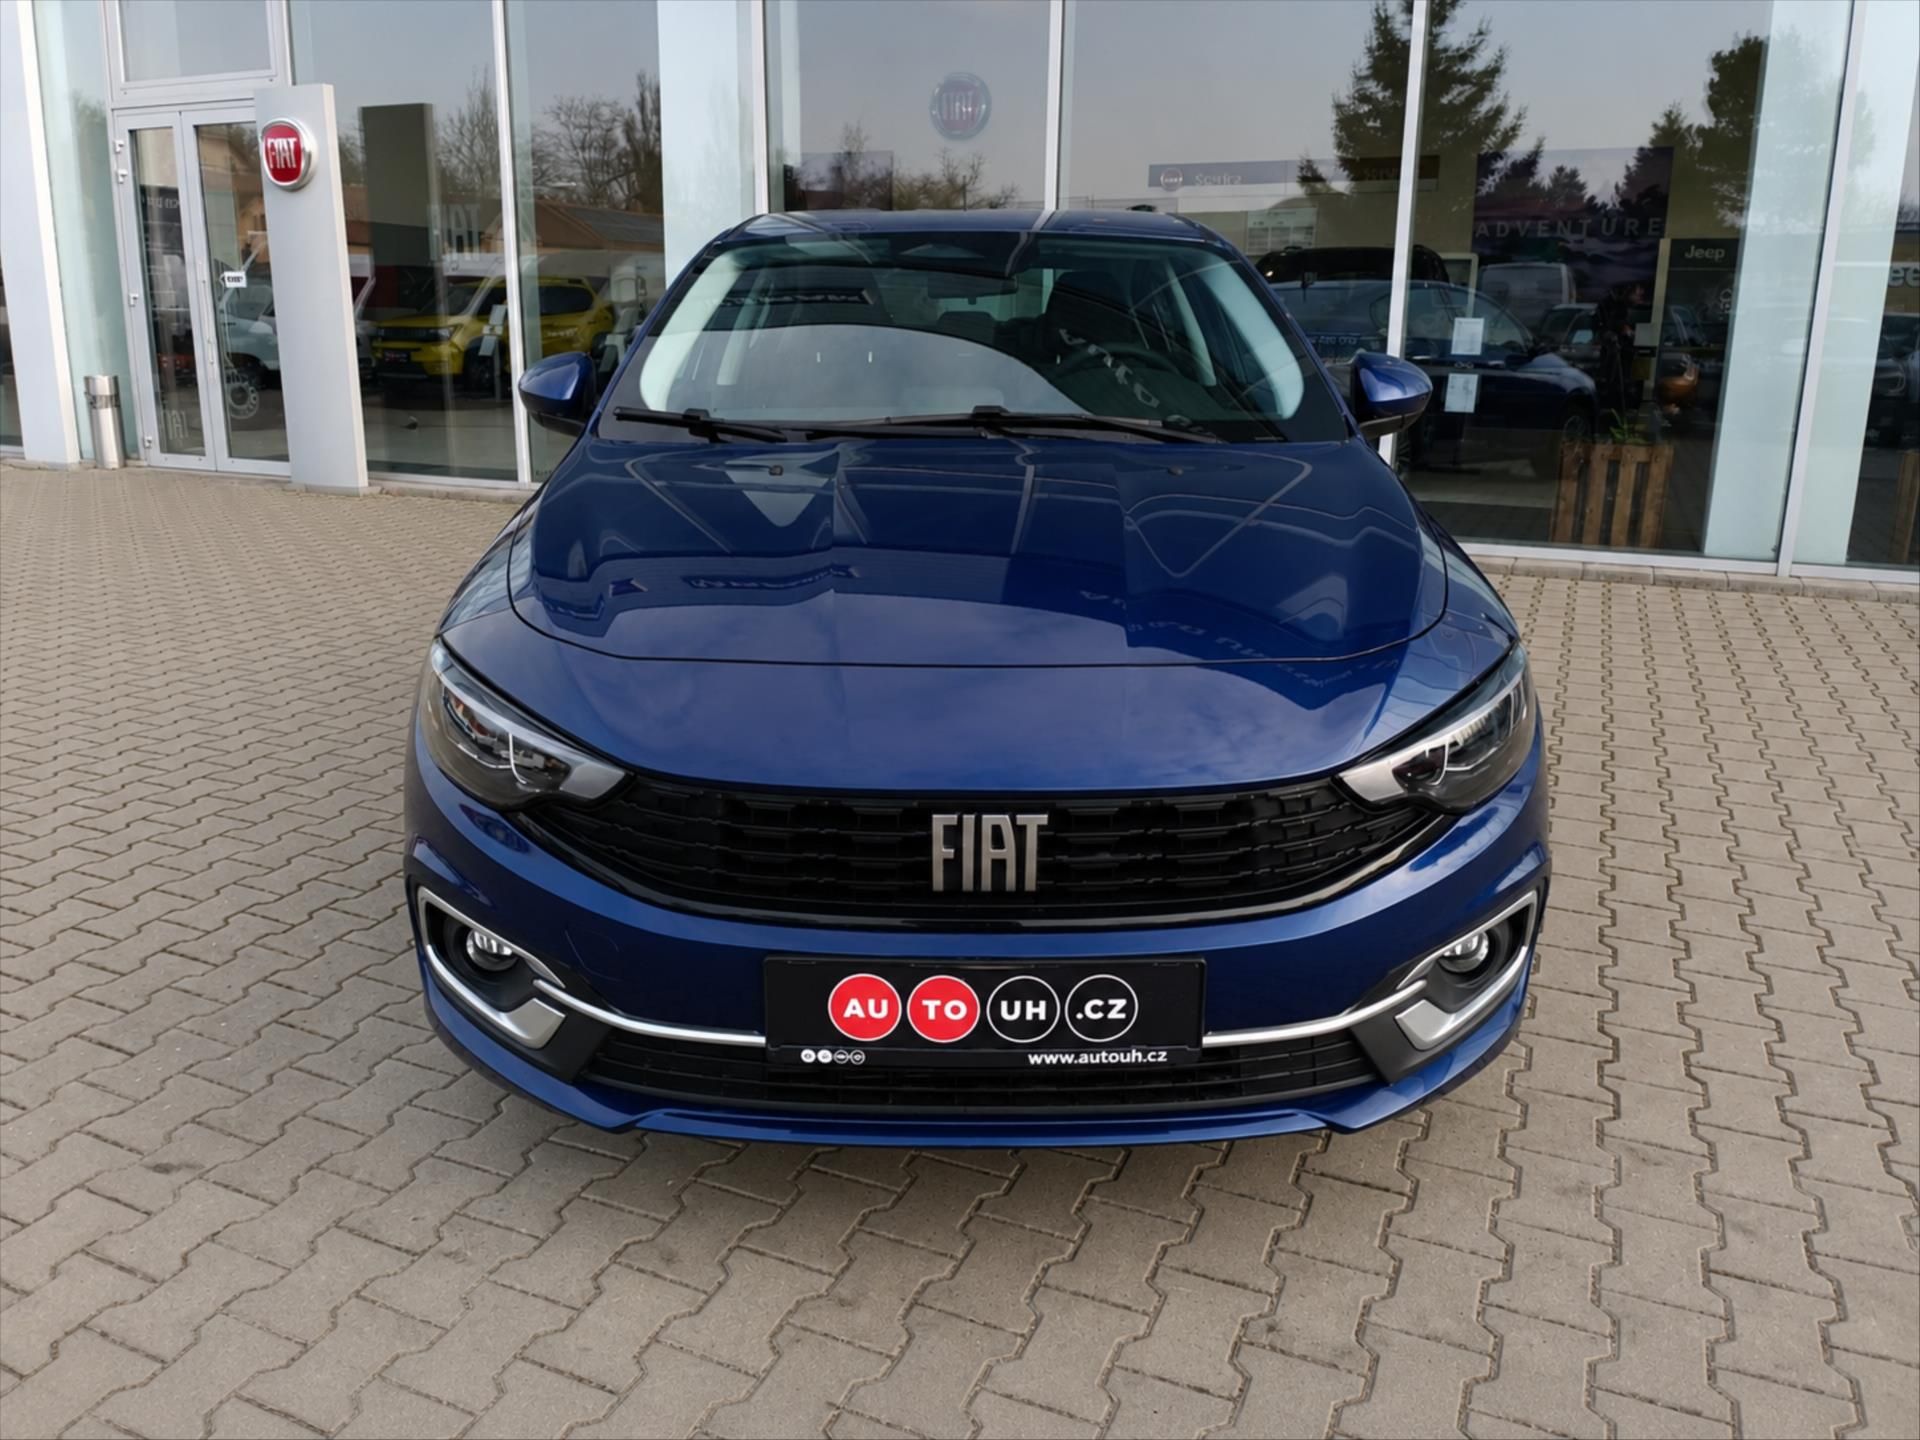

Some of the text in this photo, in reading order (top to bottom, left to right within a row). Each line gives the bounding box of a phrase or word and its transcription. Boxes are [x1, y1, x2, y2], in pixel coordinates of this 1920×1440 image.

[266, 136, 299, 169] FIAT
[1475, 216, 1664, 239] ADVENTURE
[1685, 243, 1726, 263] Jeep
[931, 813, 1049, 892] FIAT
[842, 998, 1127, 1020] AU TO UH .CZ
[1028, 1049, 1168, 1065] www.autouh.cz
